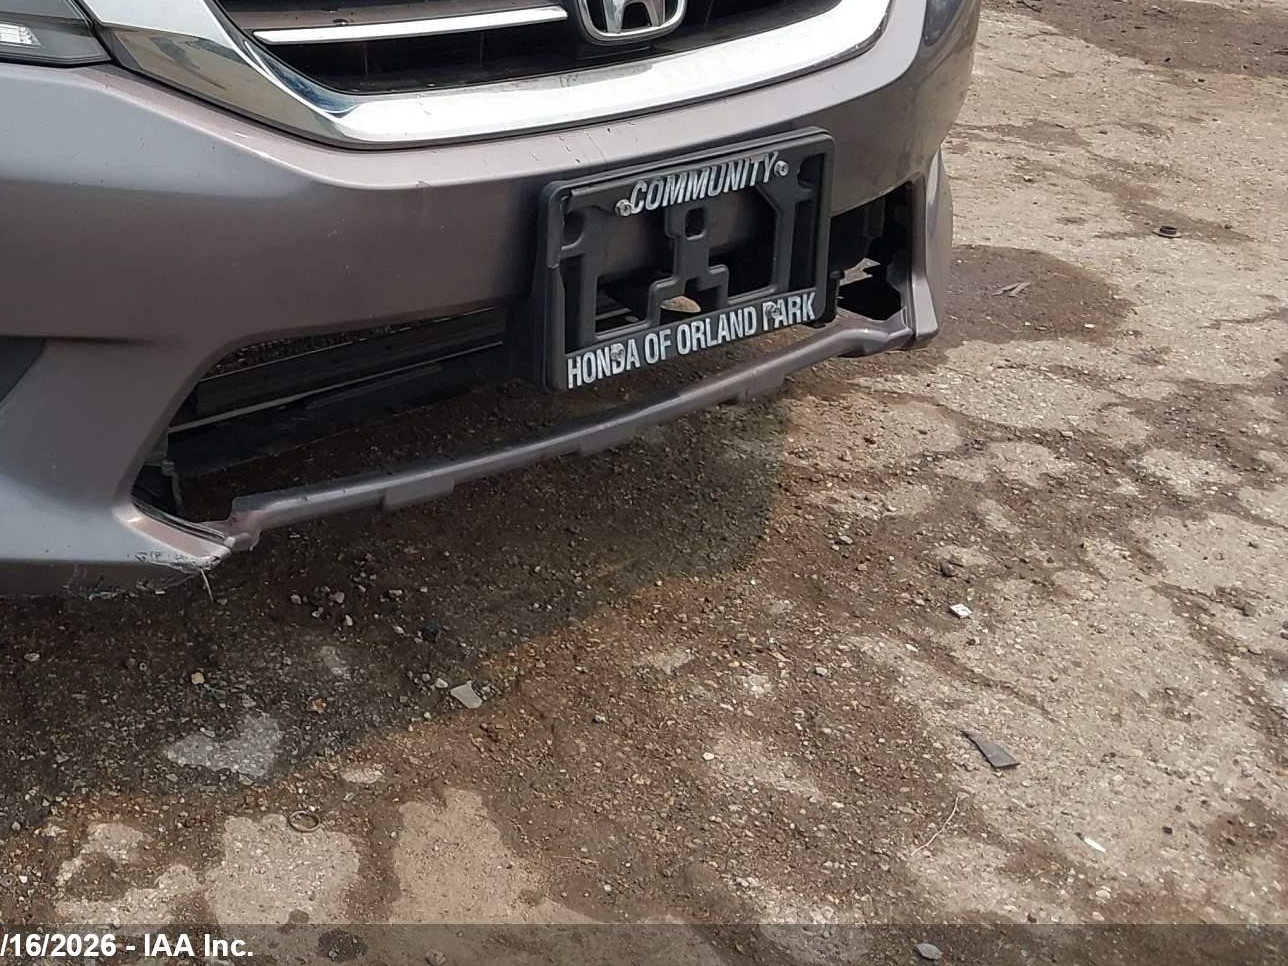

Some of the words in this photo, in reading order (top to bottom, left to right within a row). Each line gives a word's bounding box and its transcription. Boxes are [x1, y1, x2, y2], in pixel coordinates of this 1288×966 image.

[629, 151, 779, 215] COMMUNITY
[567, 338, 641, 389] HONDA
[644, 328, 672, 364] OF
[676, 305, 757, 355] ORLAND
[762, 292, 817, 331] PARK
